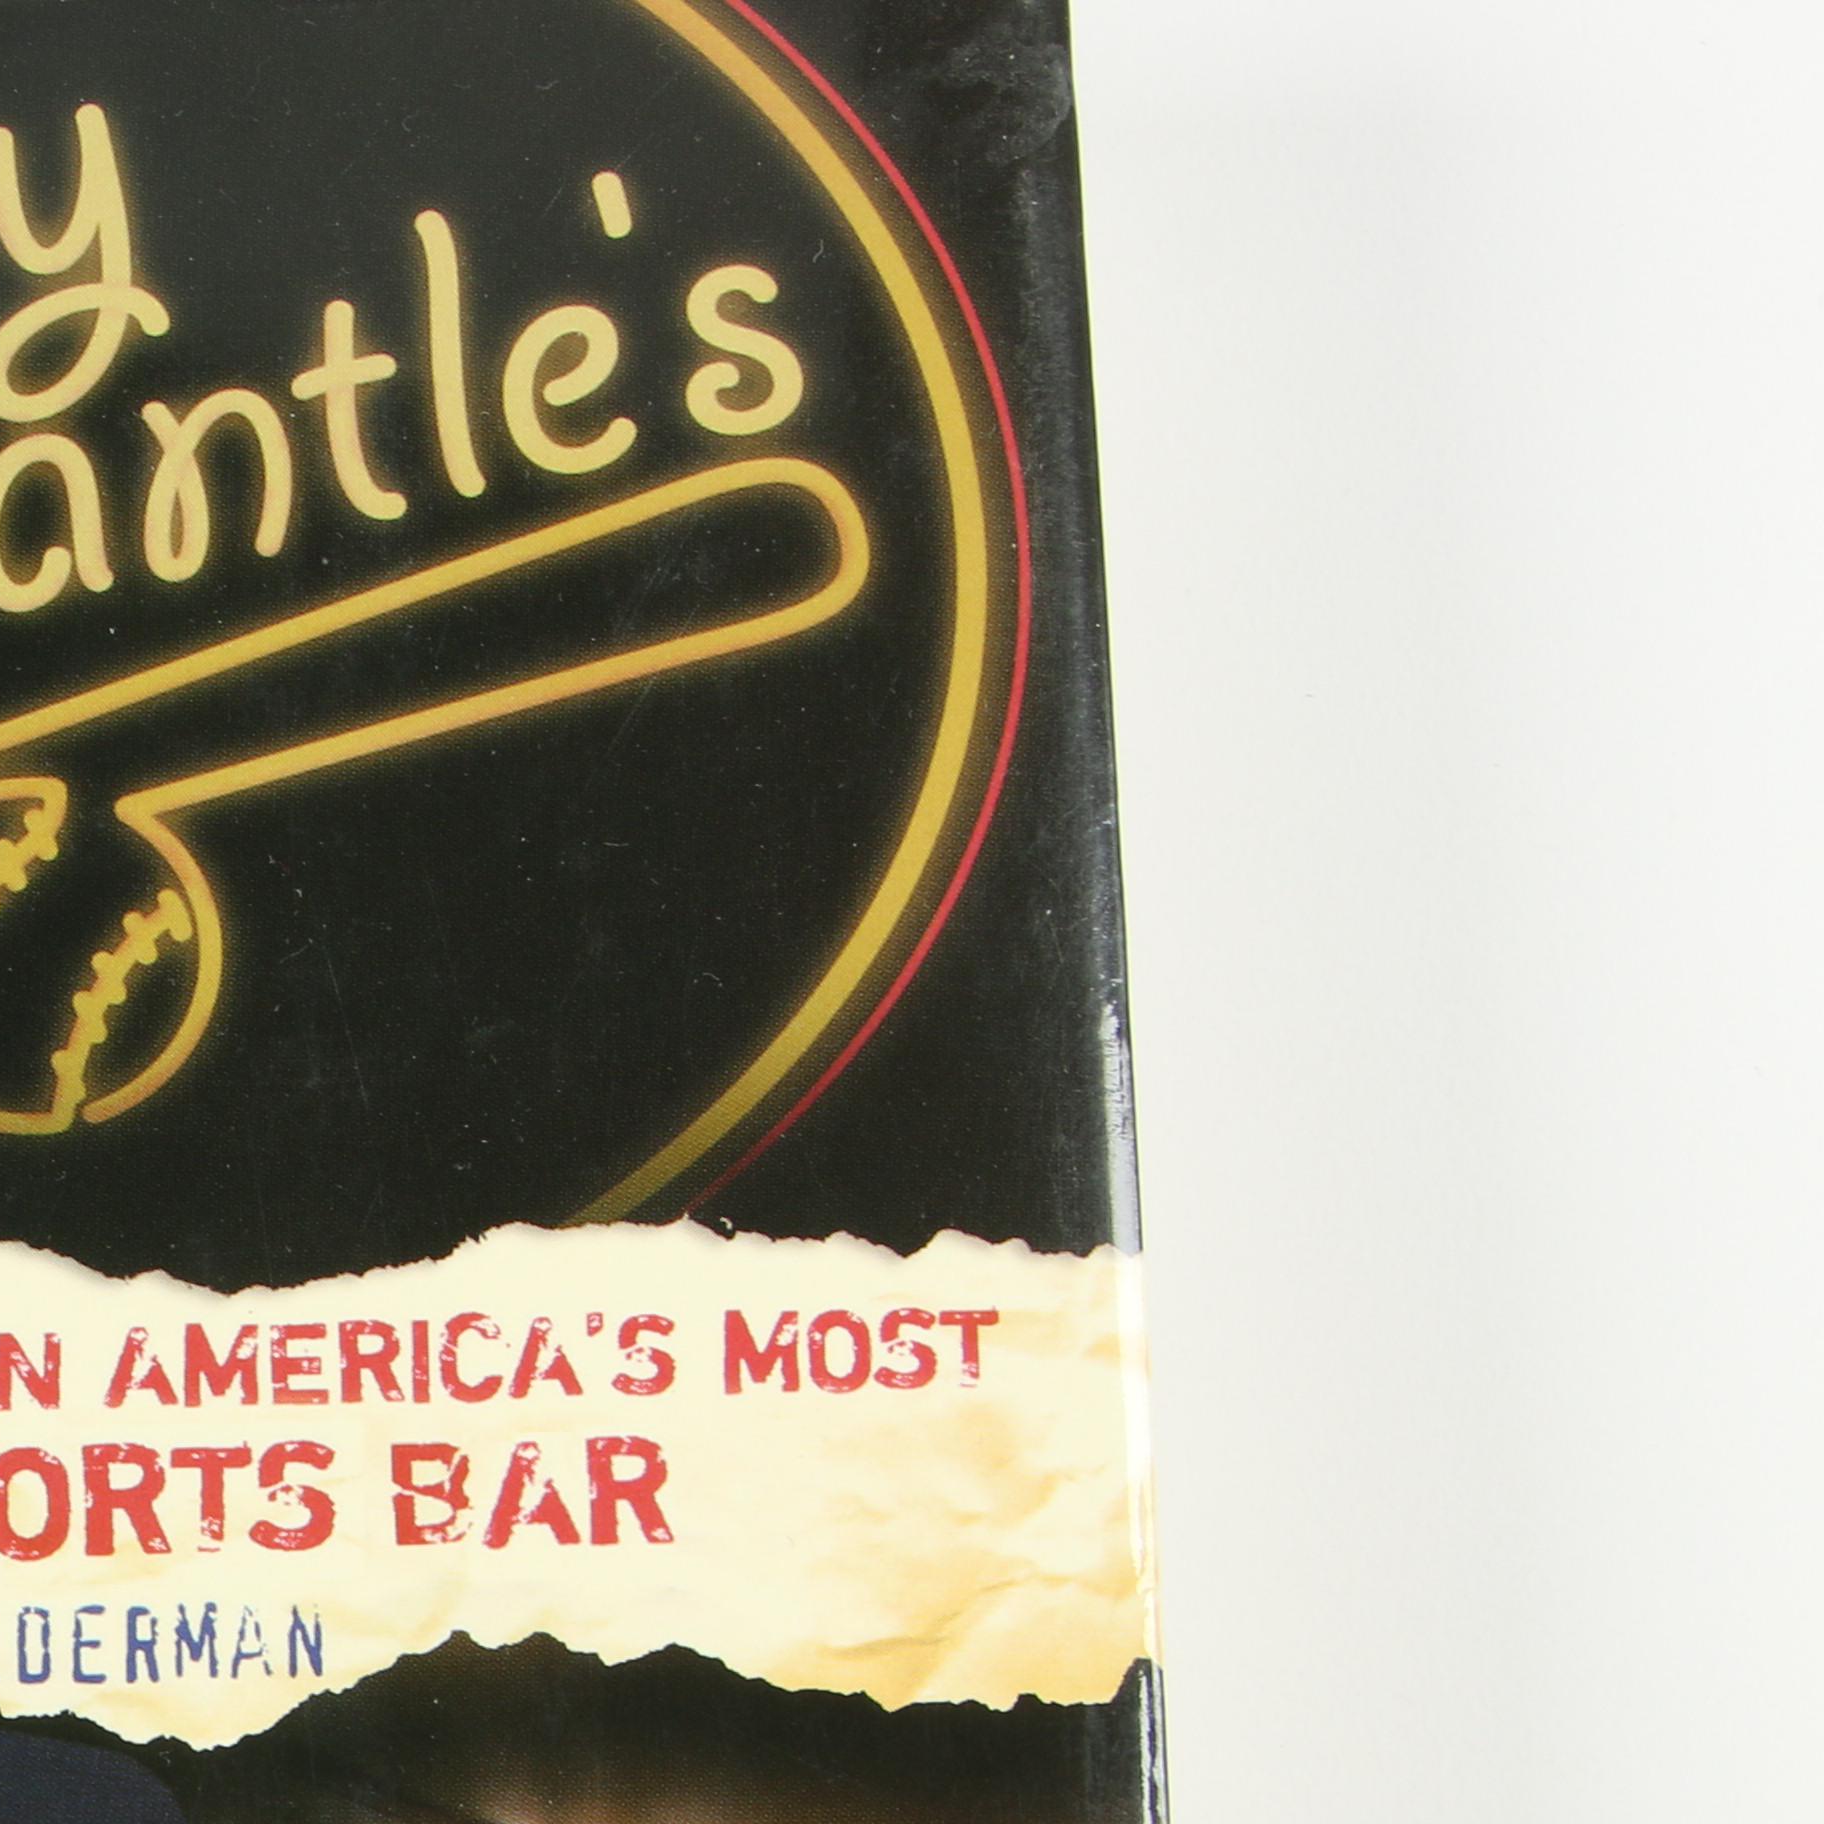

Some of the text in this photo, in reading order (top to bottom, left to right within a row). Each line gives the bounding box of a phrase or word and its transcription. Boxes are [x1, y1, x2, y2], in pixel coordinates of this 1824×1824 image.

[105, 1311, 677, 1410] AMERICA'S
[722, 1306, 1002, 1398] MOST
[390, 1435, 674, 1551] BAR
